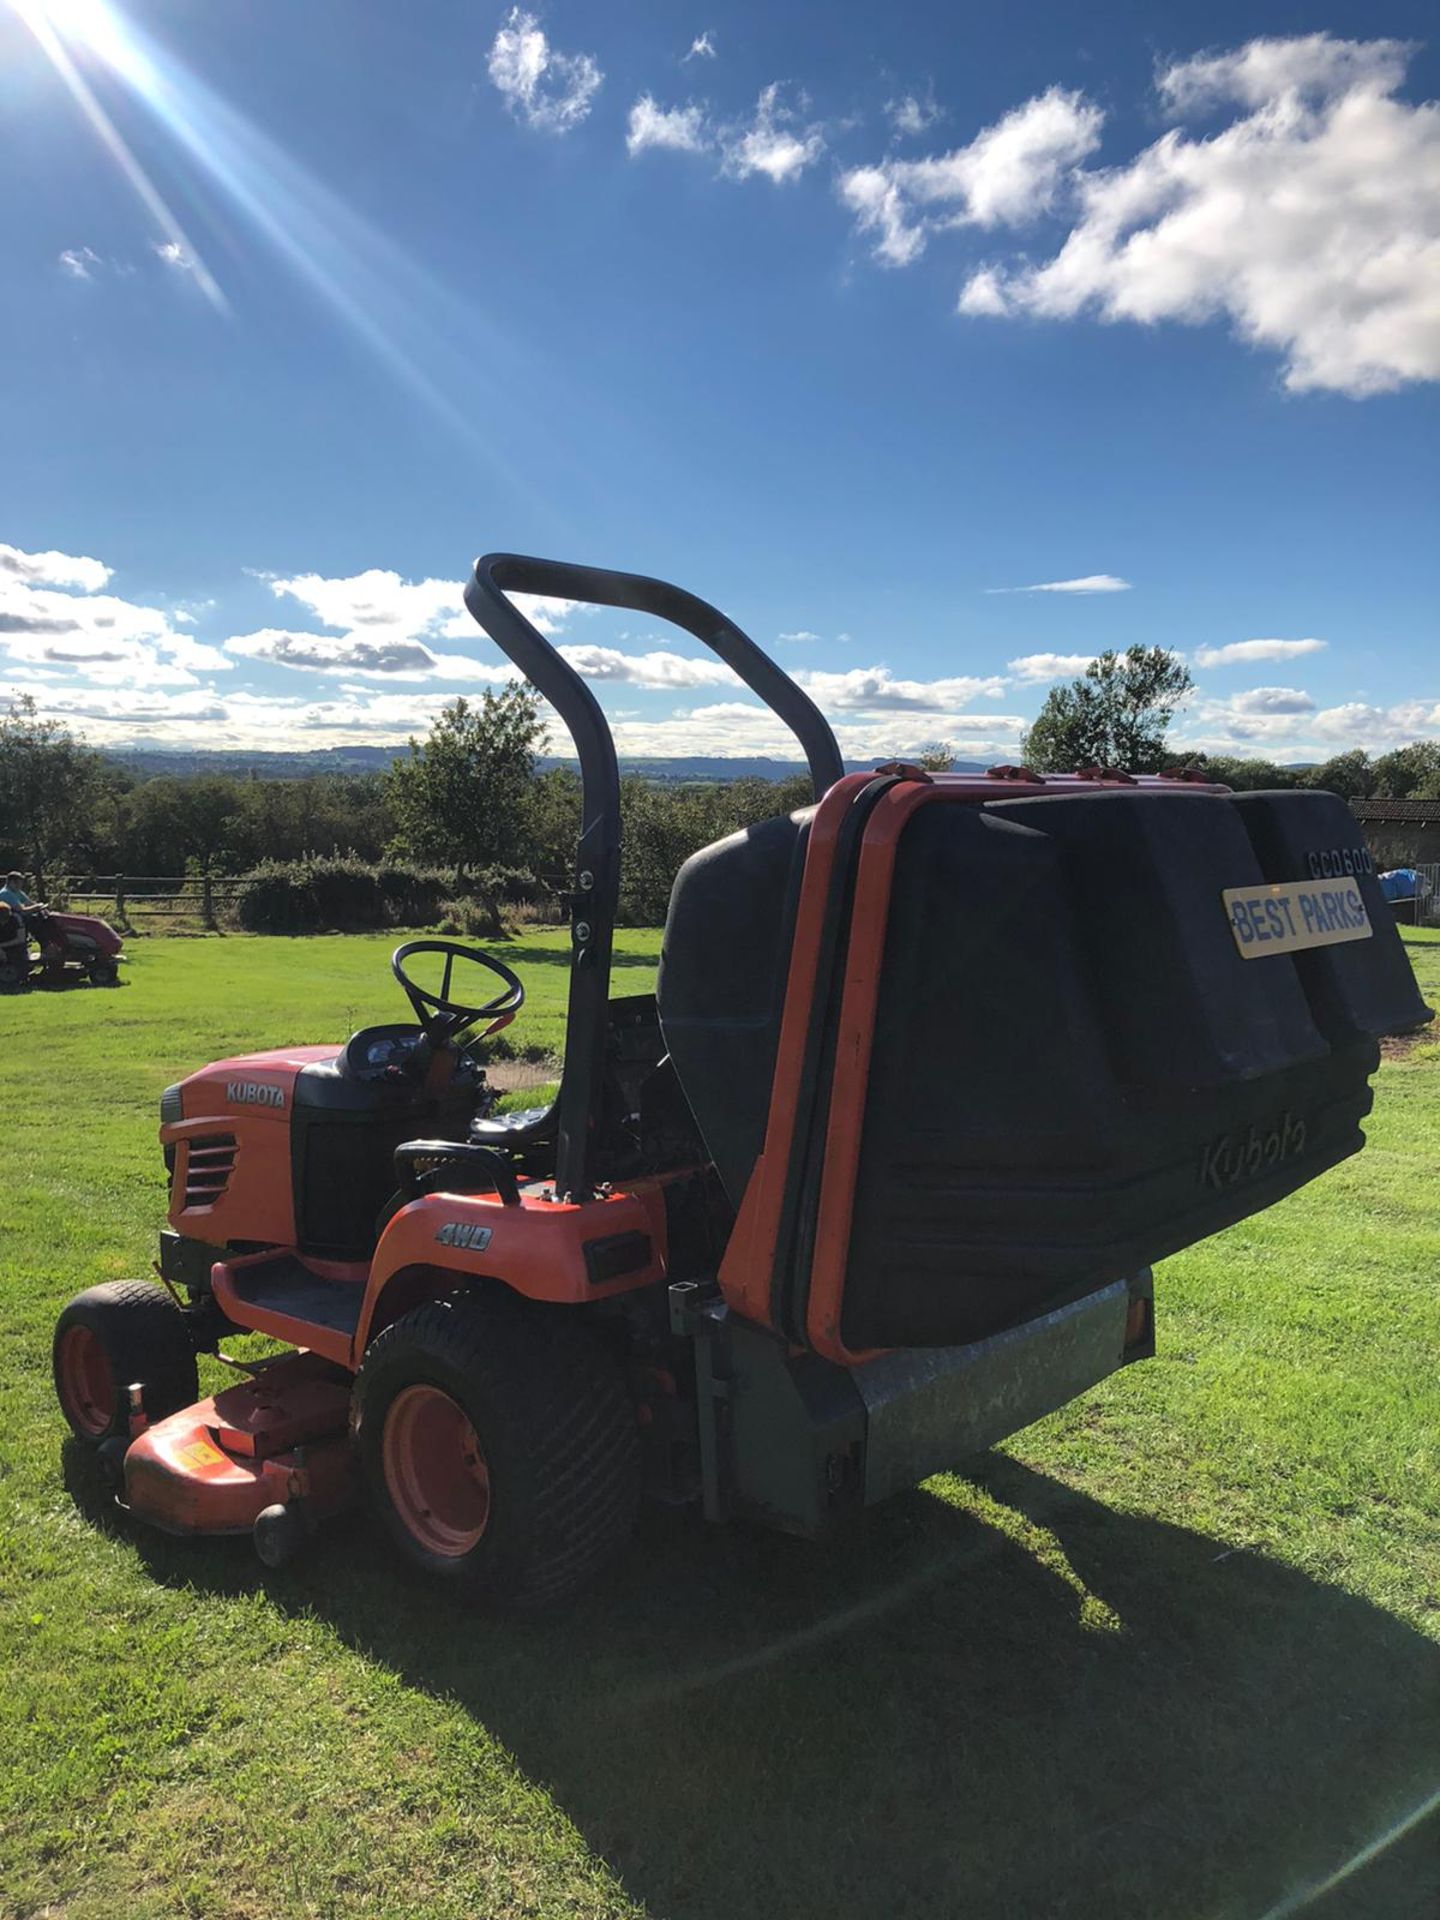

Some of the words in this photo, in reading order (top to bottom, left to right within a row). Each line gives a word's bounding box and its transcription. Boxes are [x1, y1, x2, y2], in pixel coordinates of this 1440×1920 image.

[1232, 897, 1297, 943] BEST
[1298, 889, 1365, 934] PARKS
[227, 1081, 285, 1107] KUBOTA
[1199, 1111, 1306, 1190] Kubota
[434, 1222, 493, 1251] 4WD
